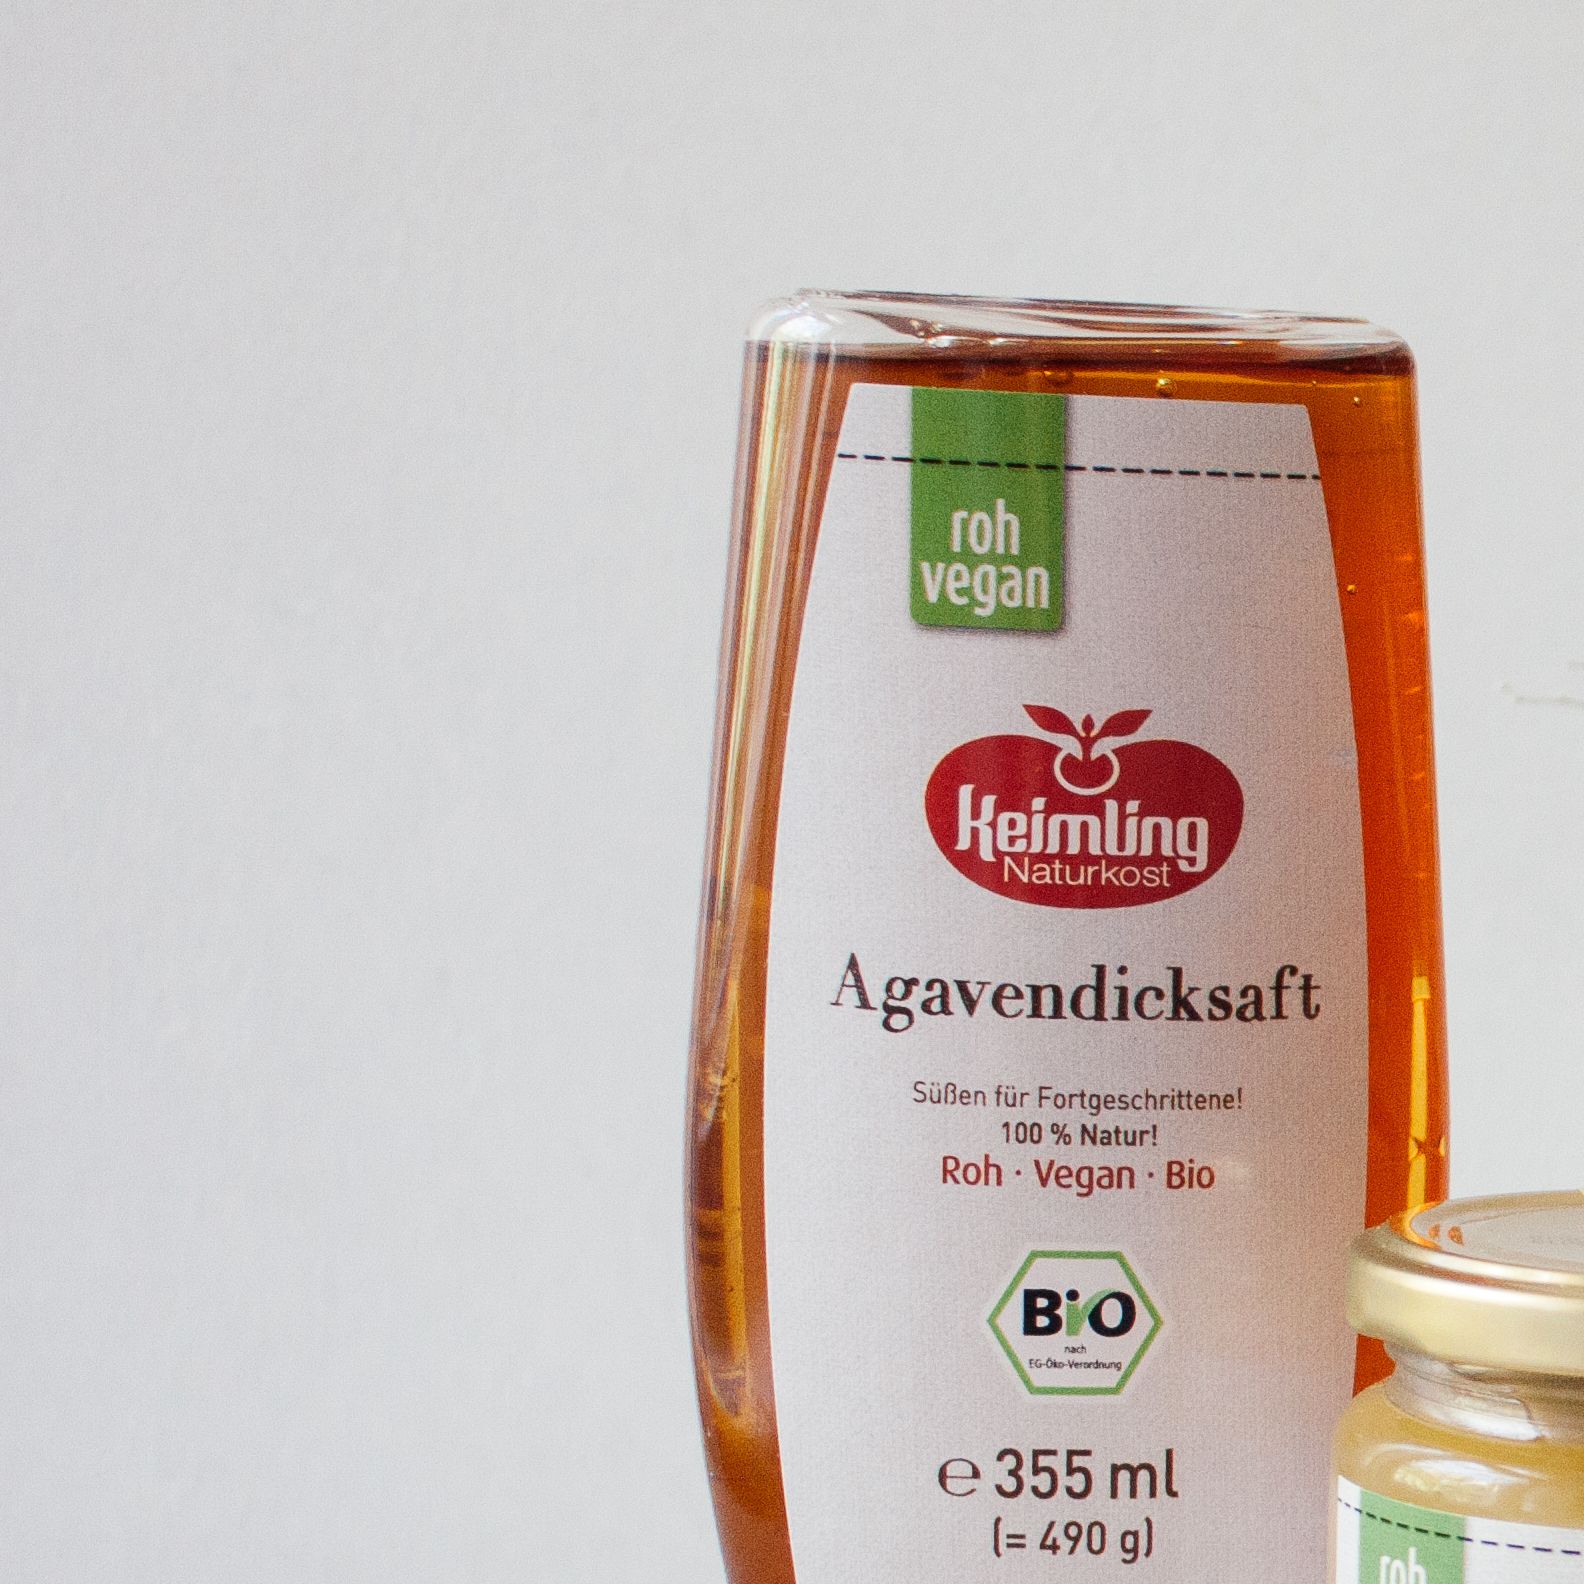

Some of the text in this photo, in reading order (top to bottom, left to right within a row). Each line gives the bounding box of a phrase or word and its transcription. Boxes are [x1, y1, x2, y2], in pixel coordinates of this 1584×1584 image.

[951, 499, 1020, 555] roh
[920, 561, 1050, 617] vegan
[955, 783, 1210, 873] Keimling
[1003, 855, 1172, 888] Naturkost
[830, 952, 1322, 1033] Agavendicksaft
[913, 1081, 1243, 1116] Süßen für Fortgeschrittene!
[1001, 1121, 1158, 1147] 100 % Natur!
[941, 1153, 1003, 1187] Roh
[1033, 1159, 1136, 1198] Vegan
[1165, 1158, 1216, 1190] Bio
[1064, 1344, 1087, 1354] nach
[994, 1447, 1093, 1500] 355
[1109, 1447, 1180, 1499] ml
[1038, 1519, 1107, 1556] 490
[1120, 1516, 1154, 1564] g)
